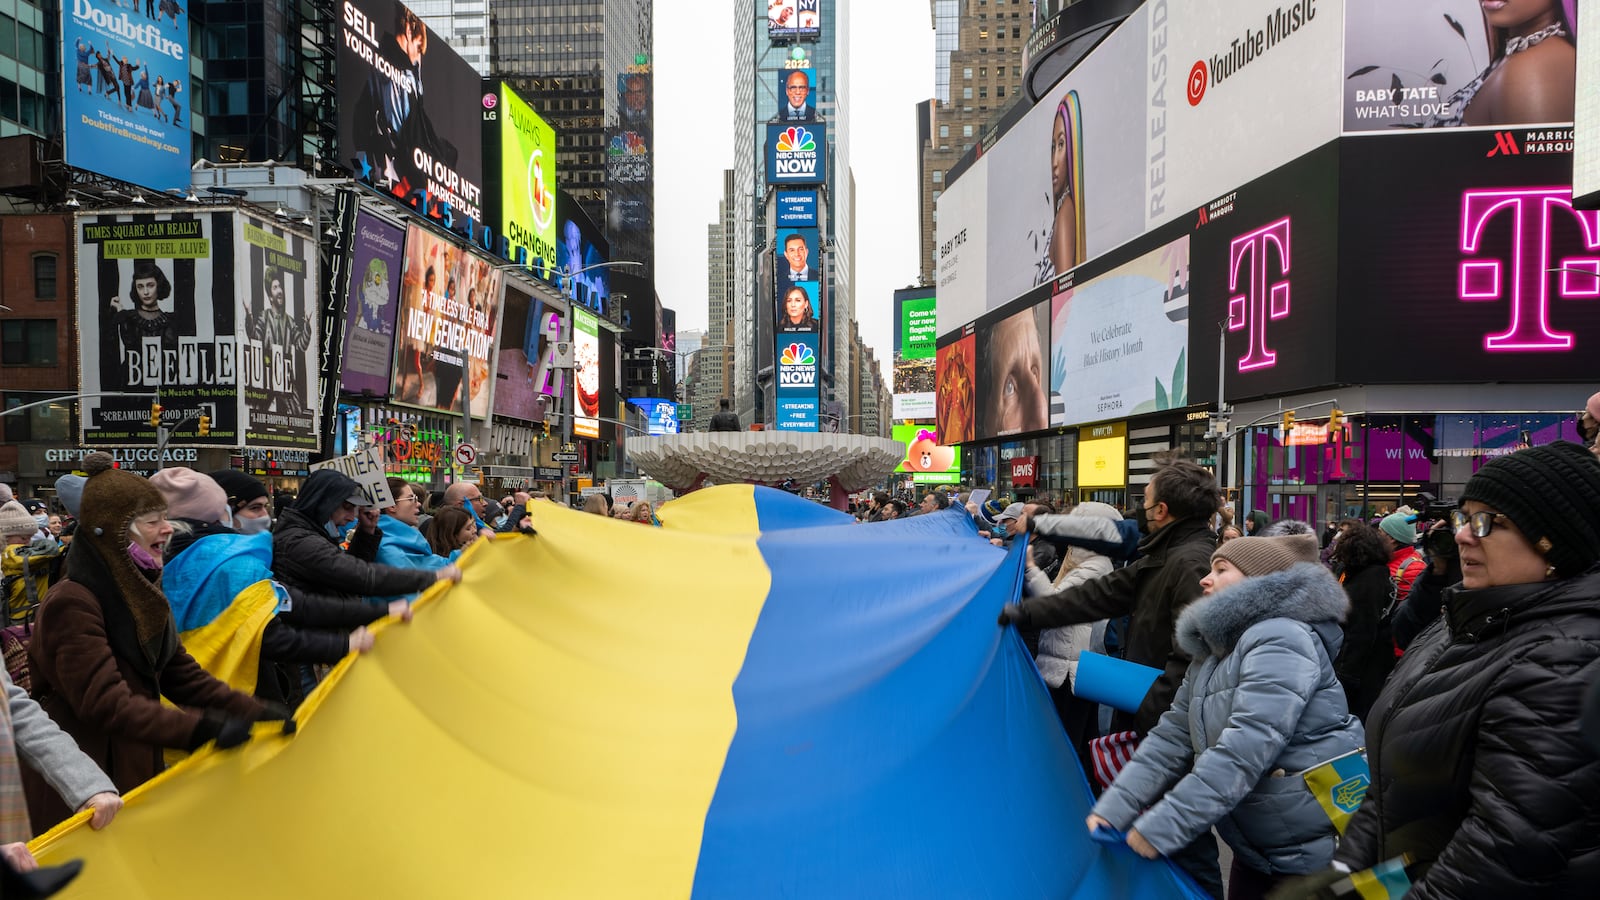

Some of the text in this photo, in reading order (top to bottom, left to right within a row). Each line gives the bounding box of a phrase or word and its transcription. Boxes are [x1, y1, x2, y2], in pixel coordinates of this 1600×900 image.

[72, 0, 184, 60] Doubtfire
[343, 1, 379, 48] SELL
[1209, 0, 1316, 88] YouTube Music
[343, 28, 412, 94] YOUR ICONICS
[784, 59, 810, 69] 2022
[1356, 87, 1437, 102] BABY TATE
[482, 111, 497, 120] LG
[1150, 0, 1168, 219] RELEASED
[1356, 103, 1450, 119] WHAT'S LOVE
[98, 110, 124, 125] Tickets
[124, 121, 134, 129] on
[134, 124, 148, 134] sale
[509, 104, 541, 147] ALWAYS
[81, 114, 180, 154] DoubtfireBroadway.com
[794, 151, 816, 159] NEWS
[776, 159, 816, 173] NOW
[413, 148, 481, 206] ON OUR NFT
[427, 178, 481, 223] MARKETPLACE
[1210, 192, 1237, 211] MARRIOTT
[1210, 203, 1233, 221] MARQUIS
[85, 221, 198, 239] TIMES SQUARE CAN REALLY
[955, 228, 967, 248] TATE
[107, 241, 206, 255] MAKE YOU FEEL ALIVE!
[509, 221, 556, 264] CHANGING
[429, 290, 459, 318] TIMELESS
[459, 304, 472, 324] TALE
[473, 308, 484, 328] FOR
[484, 316, 489, 330] A
[407, 308, 434, 343] NEW
[909, 325, 936, 334] flagship
[1090, 322, 1132, 344] We Celebrate
[1083, 337, 1143, 367] Black History Month
[780, 372, 815, 384] NOW
[197, 389, 210, 397] The
[1097, 400, 1122, 412] SEPHORA
[112, 448, 197, 461] LUGGAGE
[272, 449, 310, 462] LUGGAGE
